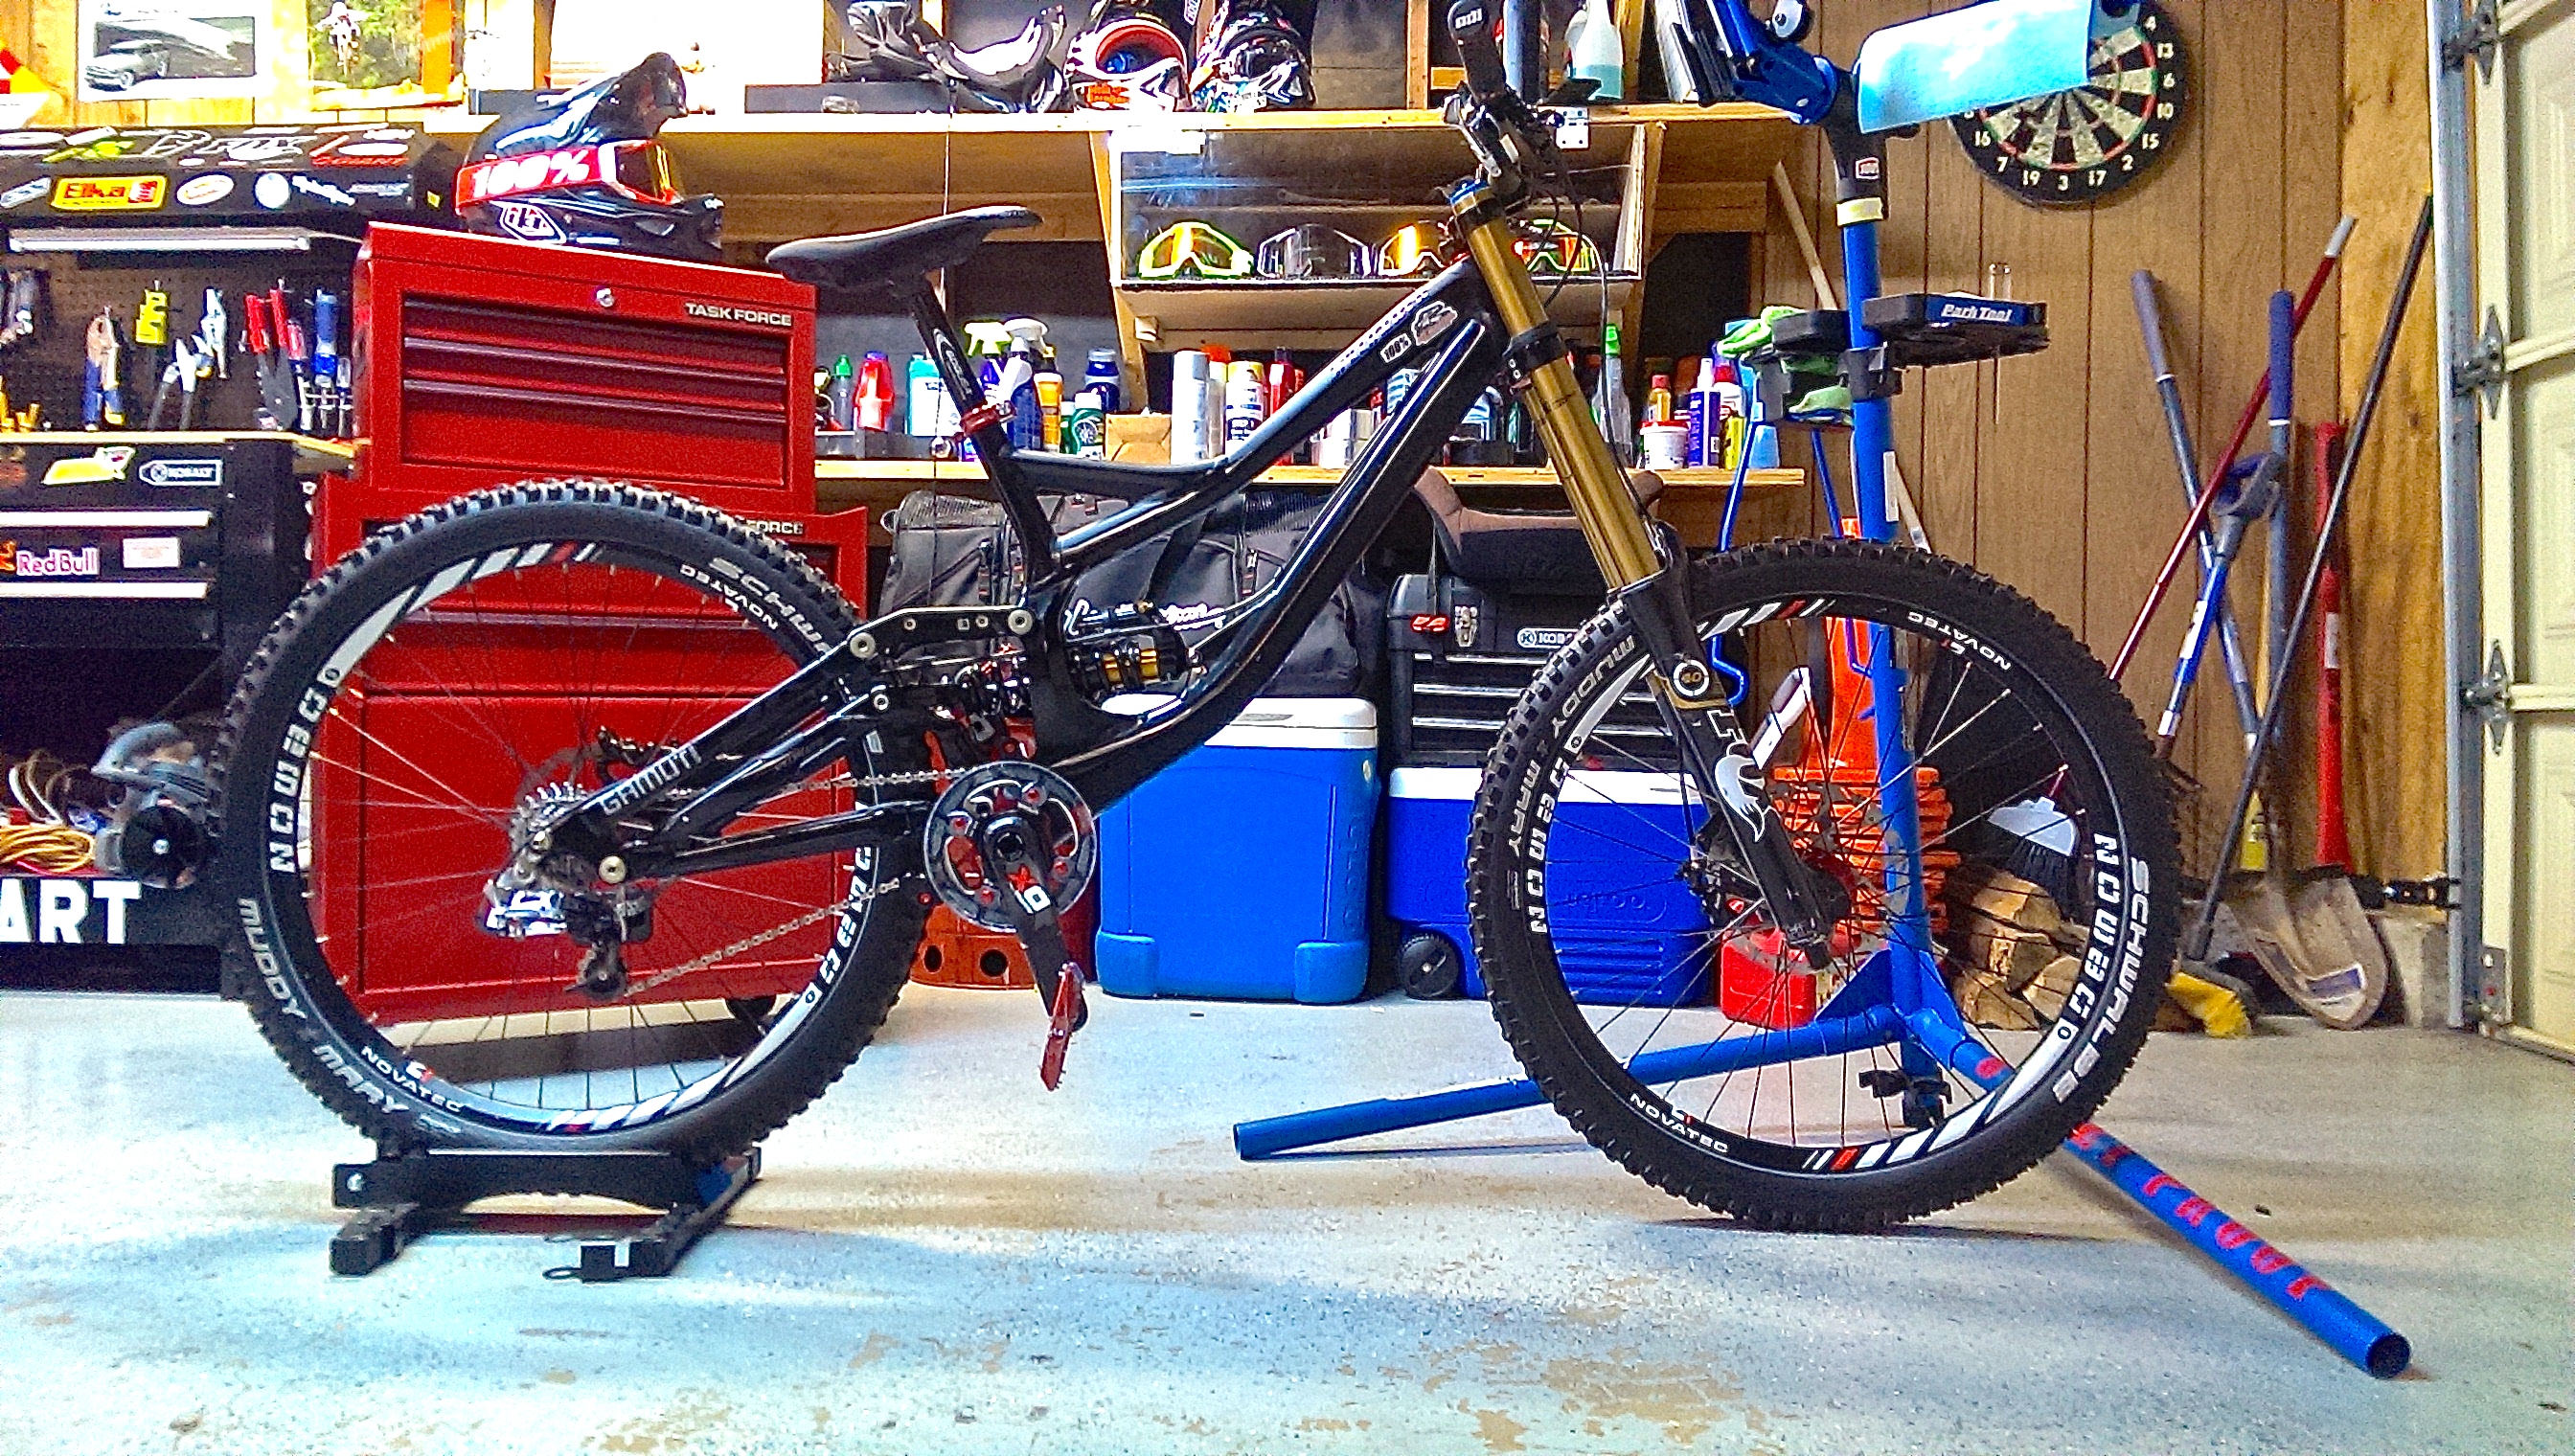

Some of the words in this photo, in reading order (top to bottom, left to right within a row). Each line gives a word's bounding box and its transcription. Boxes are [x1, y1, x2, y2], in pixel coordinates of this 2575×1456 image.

[2157, 43, 2174, 58] 13
[2163, 74, 2175, 88] 6
[2157, 102, 2175, 119] 10
[1974, 131, 1992, 147] 16
[2142, 133, 2160, 148] 15
[1997, 156, 2009, 172] 7
[2122, 156, 2134, 171] 2
[472, 148, 590, 198] 100%
[2022, 171, 2040, 187] 19
[2089, 170, 2107, 186] 17
[2058, 173, 2069, 191] 3
[64, 183, 125, 199] Elka
[685, 302, 734, 321] TASK
[734, 308, 793, 327] FORCE
[1941, 304, 1977, 320] Park
[1978, 307, 2013, 323] Tool
[680, 563, 779, 630] NOVATEC
[1907, 611, 2012, 671] NOVATEC
[2052, 856, 2150, 1103] SCHWALBE
[361, 1045, 464, 1113] NOVATEC
[1629, 1092, 1730, 1153] NOVATEC
